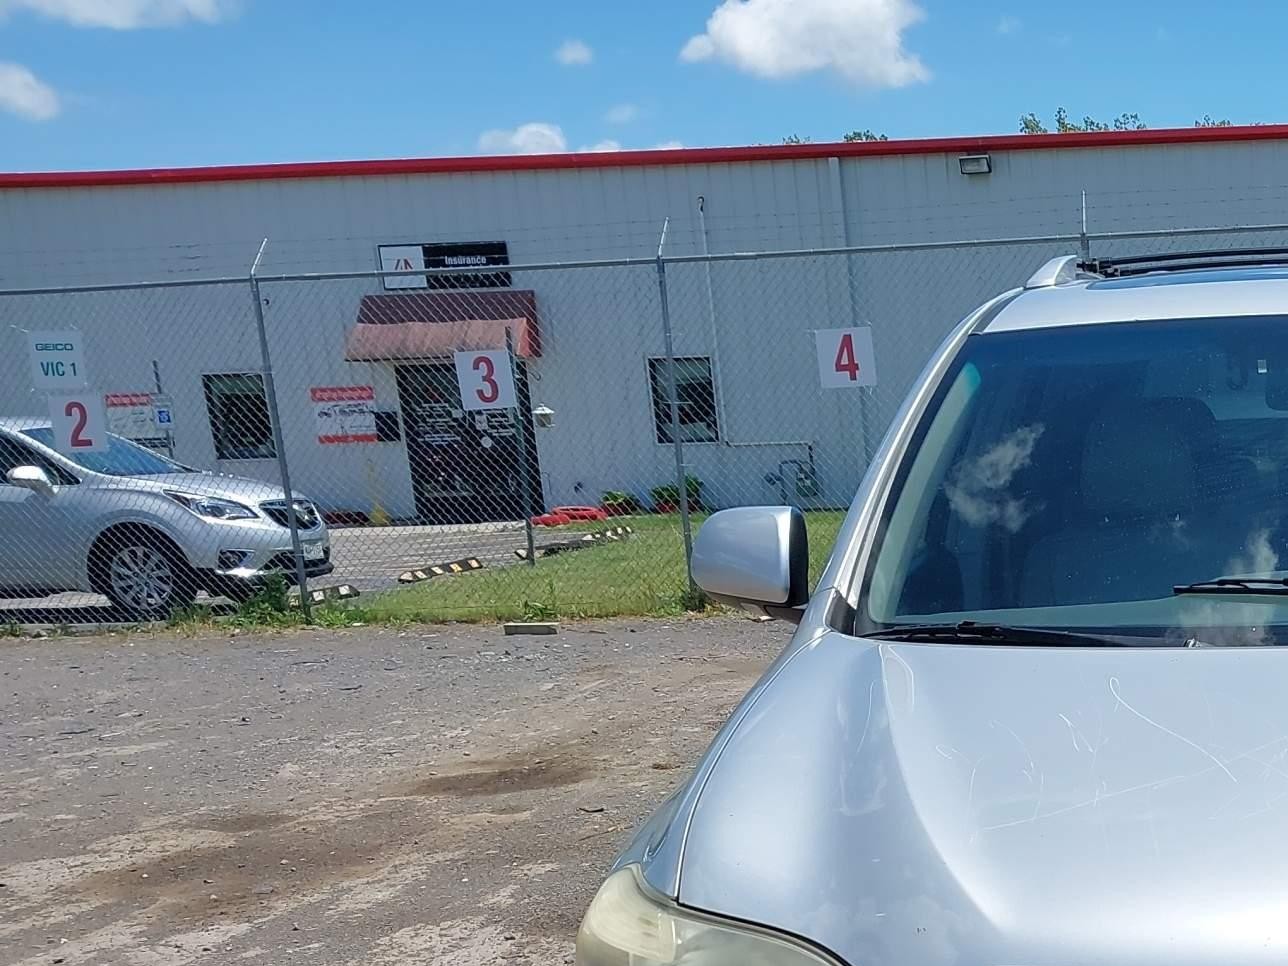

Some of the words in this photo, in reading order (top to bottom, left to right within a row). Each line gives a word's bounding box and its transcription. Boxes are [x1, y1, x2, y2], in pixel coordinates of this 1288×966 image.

[444, 255, 486, 265] Insurance
[35, 343, 74, 351] GEICO
[834, 333, 859, 381] 4
[40, 361, 65, 376] VIC
[70, 362, 77, 376] 1
[473, 356, 499, 403] 3
[64, 401, 93, 447] 2
